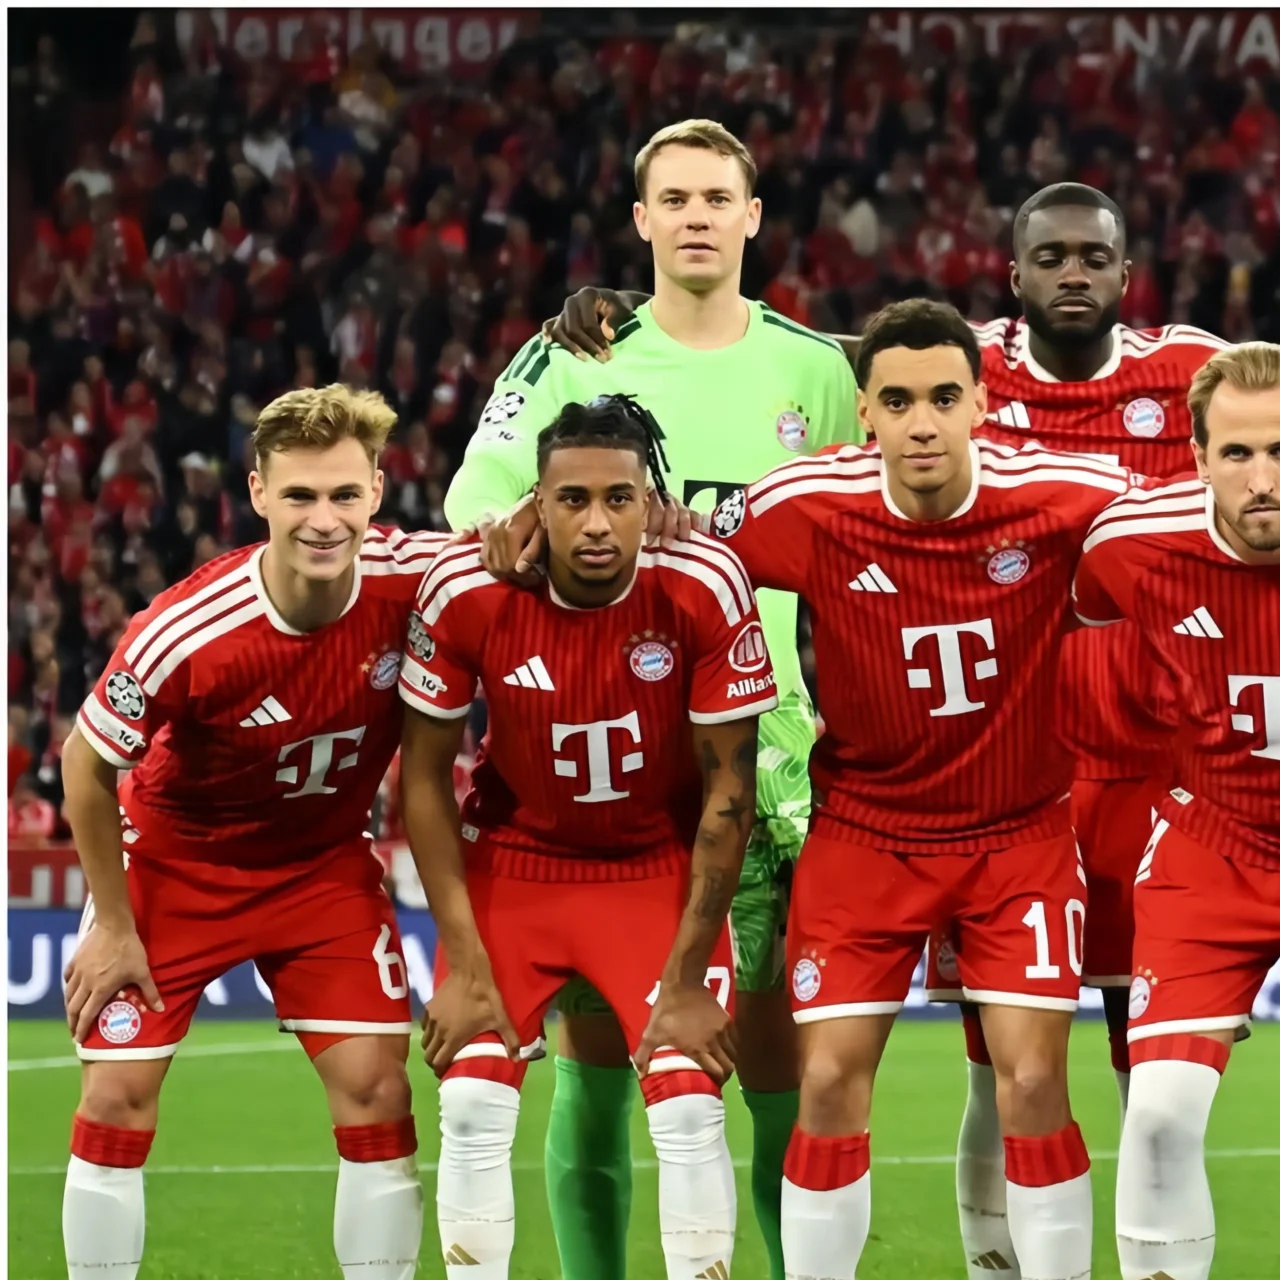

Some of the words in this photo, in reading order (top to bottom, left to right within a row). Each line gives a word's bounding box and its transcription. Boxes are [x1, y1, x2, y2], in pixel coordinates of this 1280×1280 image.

[901, 618, 998, 717] T
[276, 725, 366, 799] T
[552, 711, 645, 803] T
[372, 922, 408, 999] 6
[1022, 899, 1085, 979] 10
